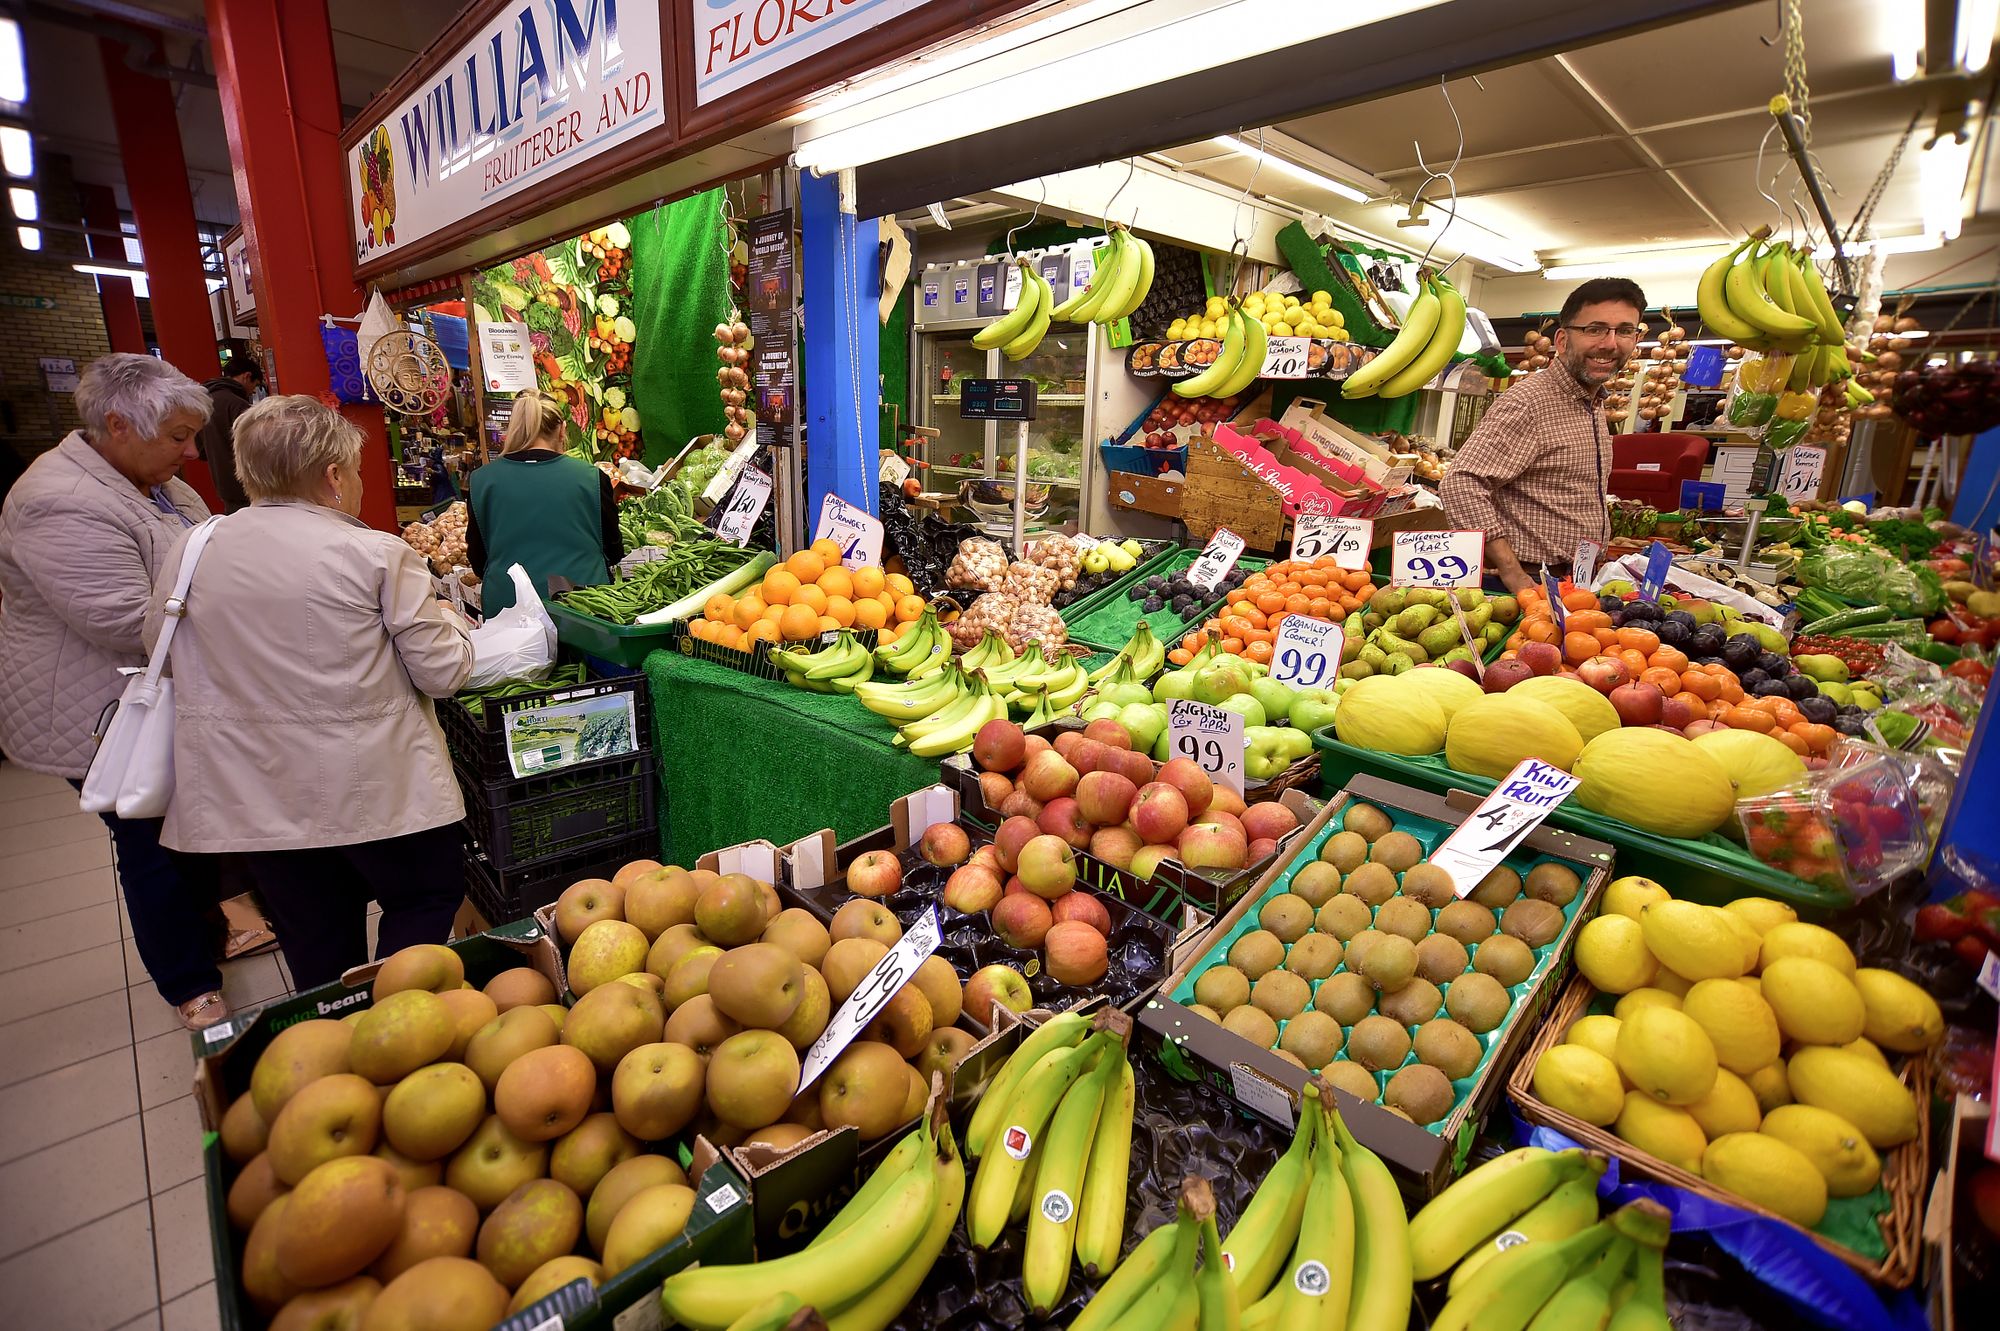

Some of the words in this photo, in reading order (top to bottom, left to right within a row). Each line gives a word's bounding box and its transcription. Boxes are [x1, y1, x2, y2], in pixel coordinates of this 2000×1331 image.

[484, 110, 584, 192] FRUITERER
[596, 71, 651, 134] AND
[758, 233, 778, 244] JOURNEY
[777, 231, 784, 241] OF
[765, 351, 783, 360] JOURNEY
[782, 351, 788, 360] OF
[1268, 344, 1302, 355] LEMONS
[1311, 430, 1354, 462] bragantini
[1260, 468, 1294, 505] Lady
[826, 495, 848, 510] LARGE
[1304, 498, 1326, 510] Pink
[828, 505, 867, 532] ORANGES
[1396, 531, 1460, 545] CONFERENCE
[1414, 541, 1450, 554] PEARS
[1283, 615, 1334, 637] BRAMLEY
[1284, 628, 1325, 648] COOKERS
[1501, 780, 1572, 808] FRUIT
[1476, 803, 1512, 831] 4
